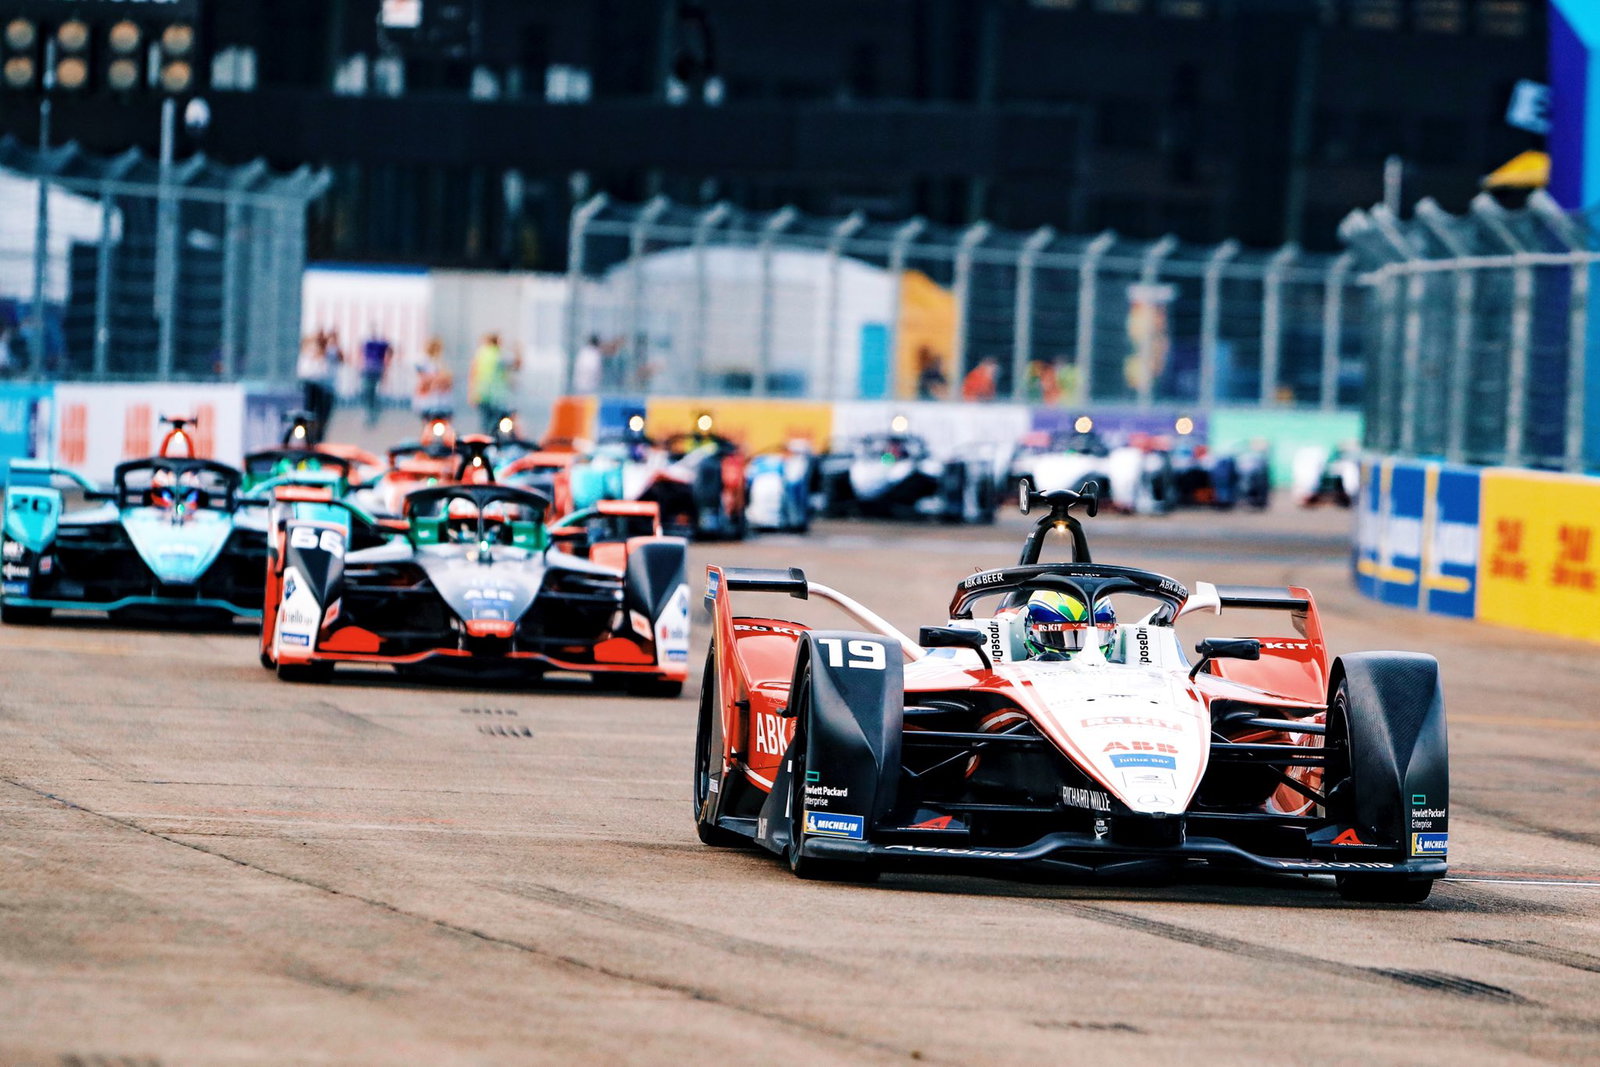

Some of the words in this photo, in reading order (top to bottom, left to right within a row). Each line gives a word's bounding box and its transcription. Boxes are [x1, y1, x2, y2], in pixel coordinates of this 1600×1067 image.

[982, 572, 1004, 585] BEER
[818, 638, 886, 670] 19
[756, 711, 787, 757] ABK
[1102, 741, 1179, 754] ABB
[823, 786, 848, 798] Packard
[1062, 785, 1090, 808] RICHARD
[1089, 790, 1112, 812] MILLE
[1411, 808, 1428, 818] Hewlett
[1428, 808, 1446, 818] Packard
[817, 819, 858, 832] MICHELIN
[1411, 819, 1432, 830] Enterprise
